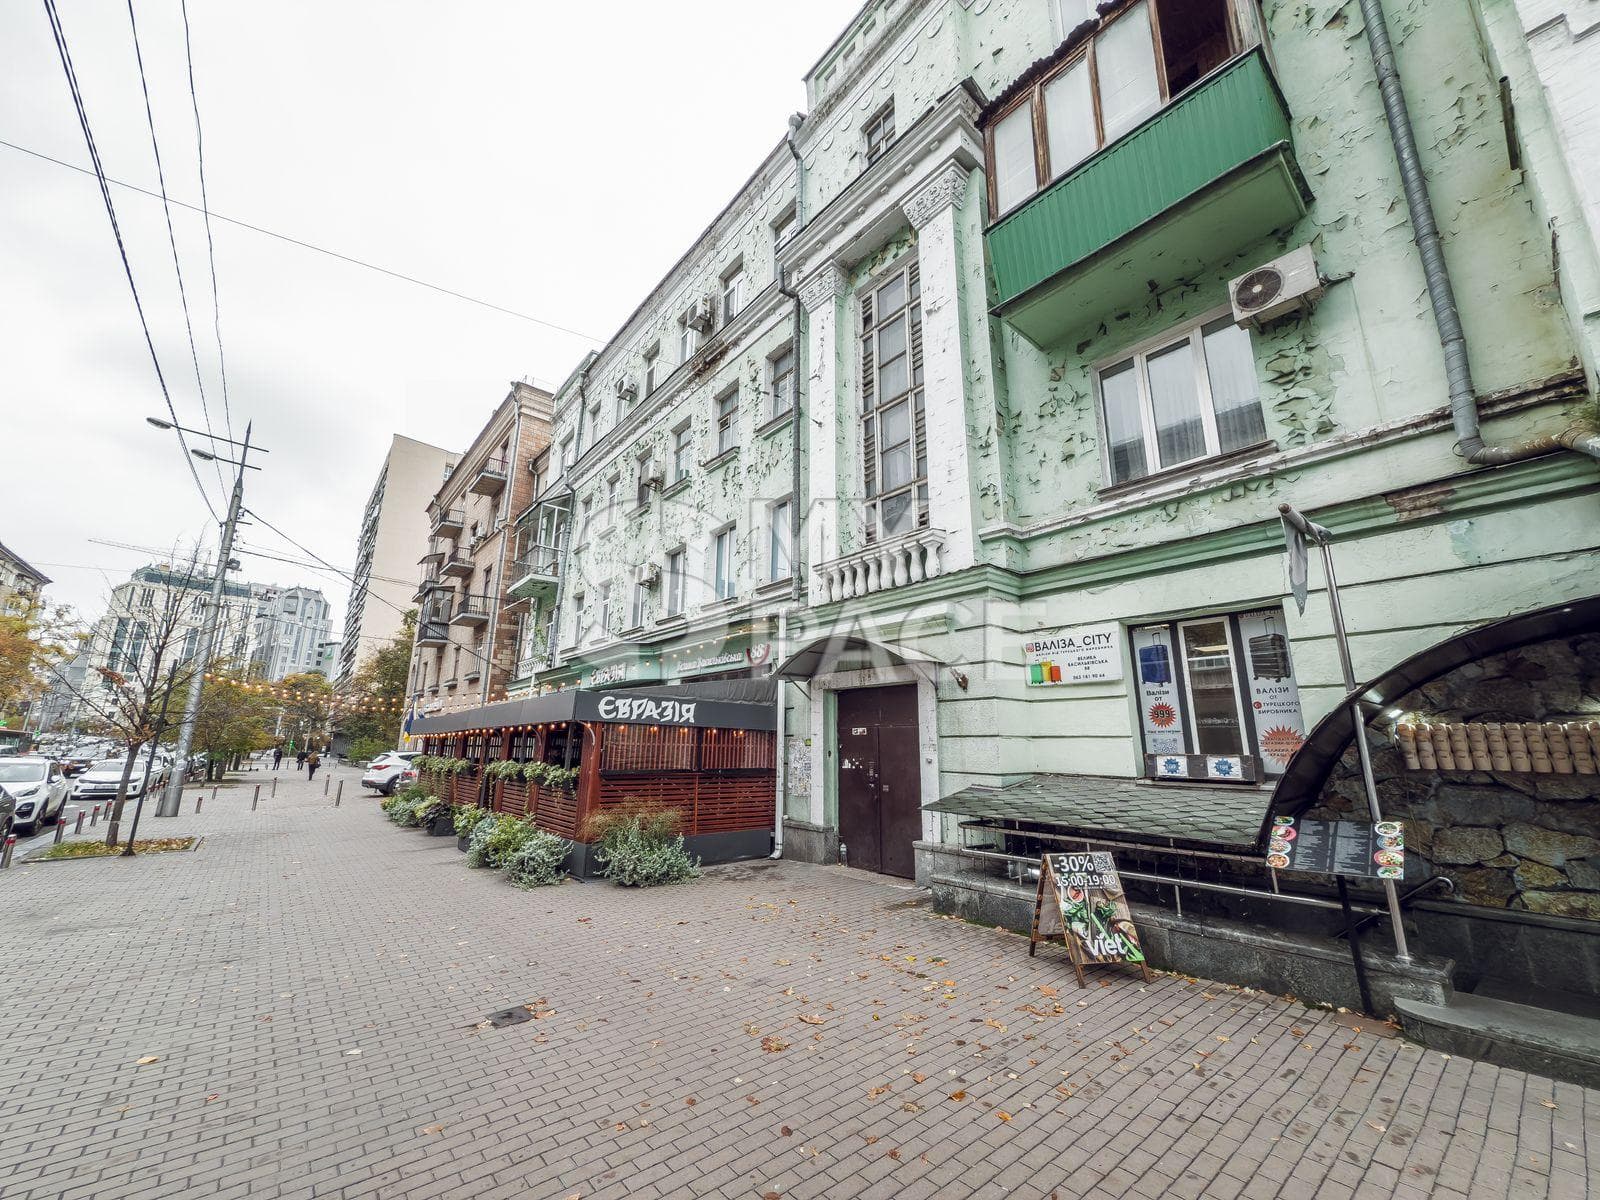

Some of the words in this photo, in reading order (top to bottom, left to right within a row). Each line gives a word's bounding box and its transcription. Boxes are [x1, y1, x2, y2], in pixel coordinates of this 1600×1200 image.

[1256, 686, 1290, 694] ВАЛІЗИ
[598, 696, 696, 723] ЄВРАЗІЯ
[1154, 709, 1171, 719] 999
[1054, 855, 1094, 872] -30%
[1055, 874, 1117, 887] 15:00-19:00
